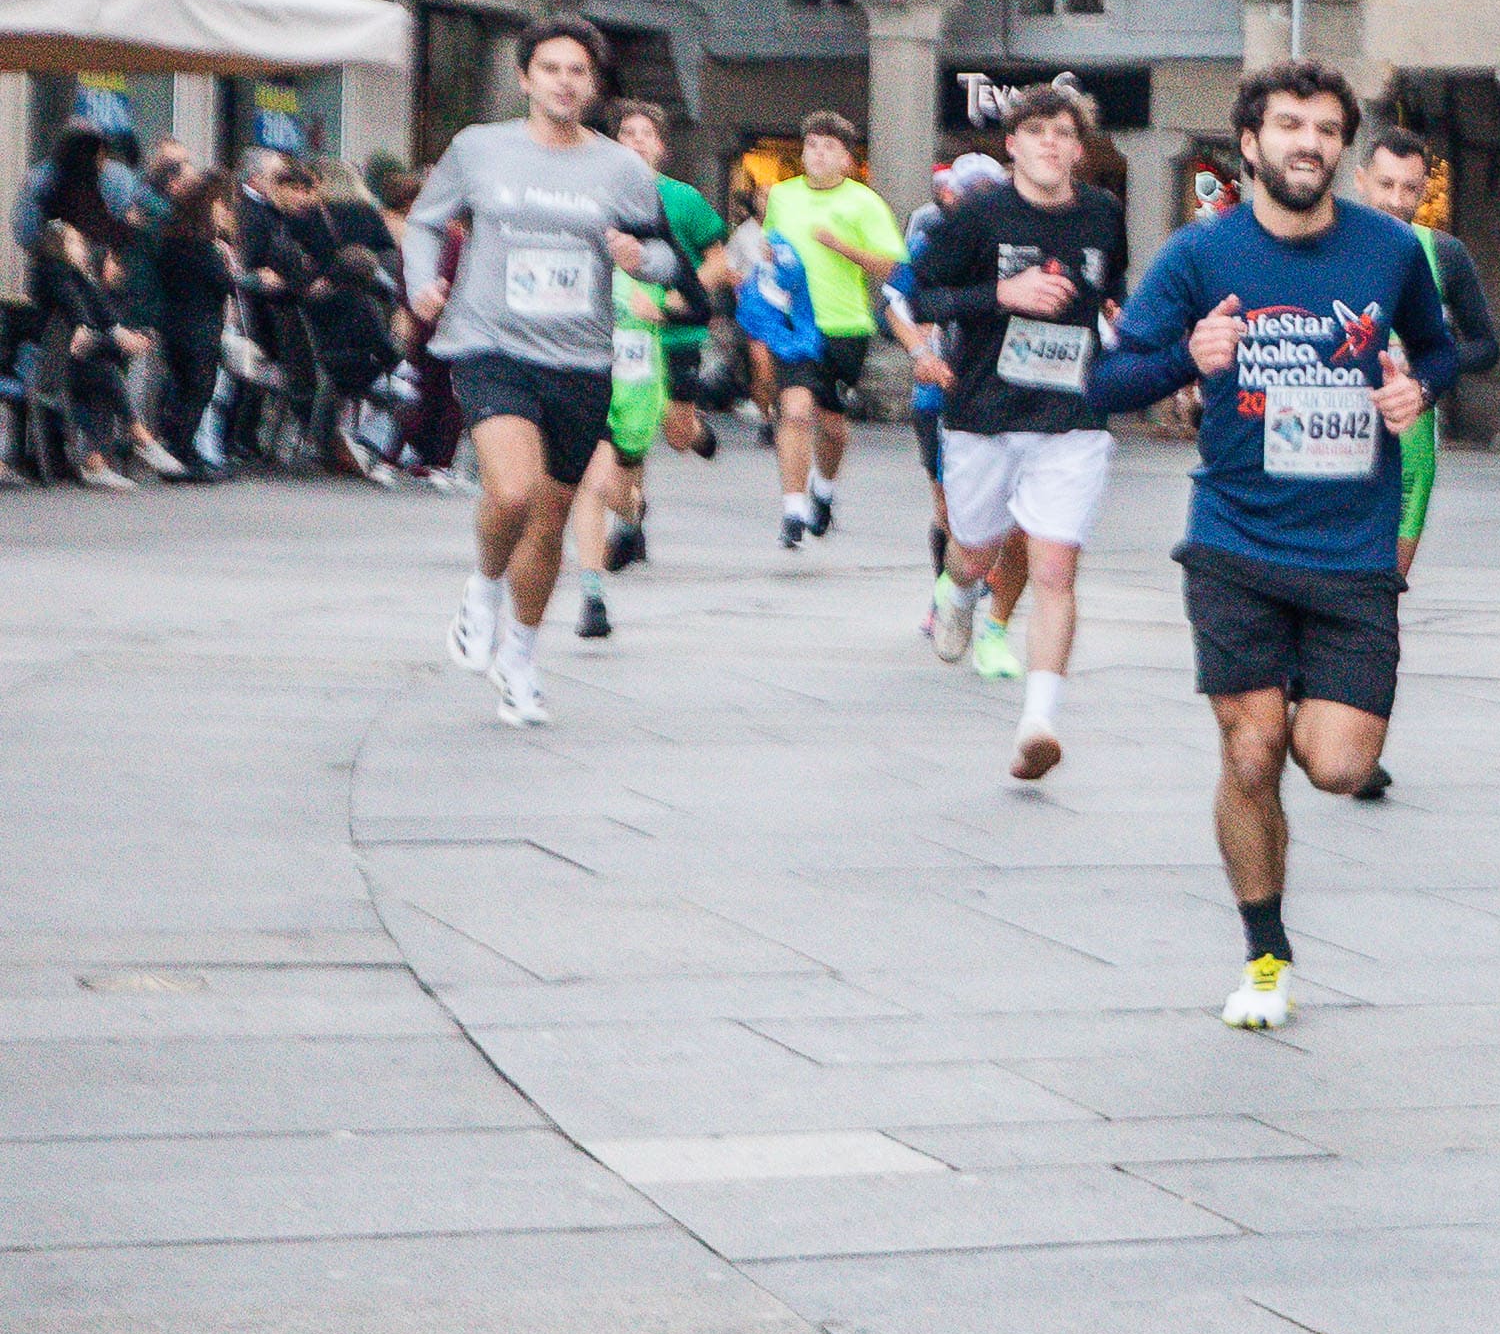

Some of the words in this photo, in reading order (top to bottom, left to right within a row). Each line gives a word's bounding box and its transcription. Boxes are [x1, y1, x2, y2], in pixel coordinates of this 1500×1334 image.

[1237, 339, 1318, 365] Malta
[1237, 361, 1366, 387] Marathon
[1308, 410, 1371, 440] 6842
